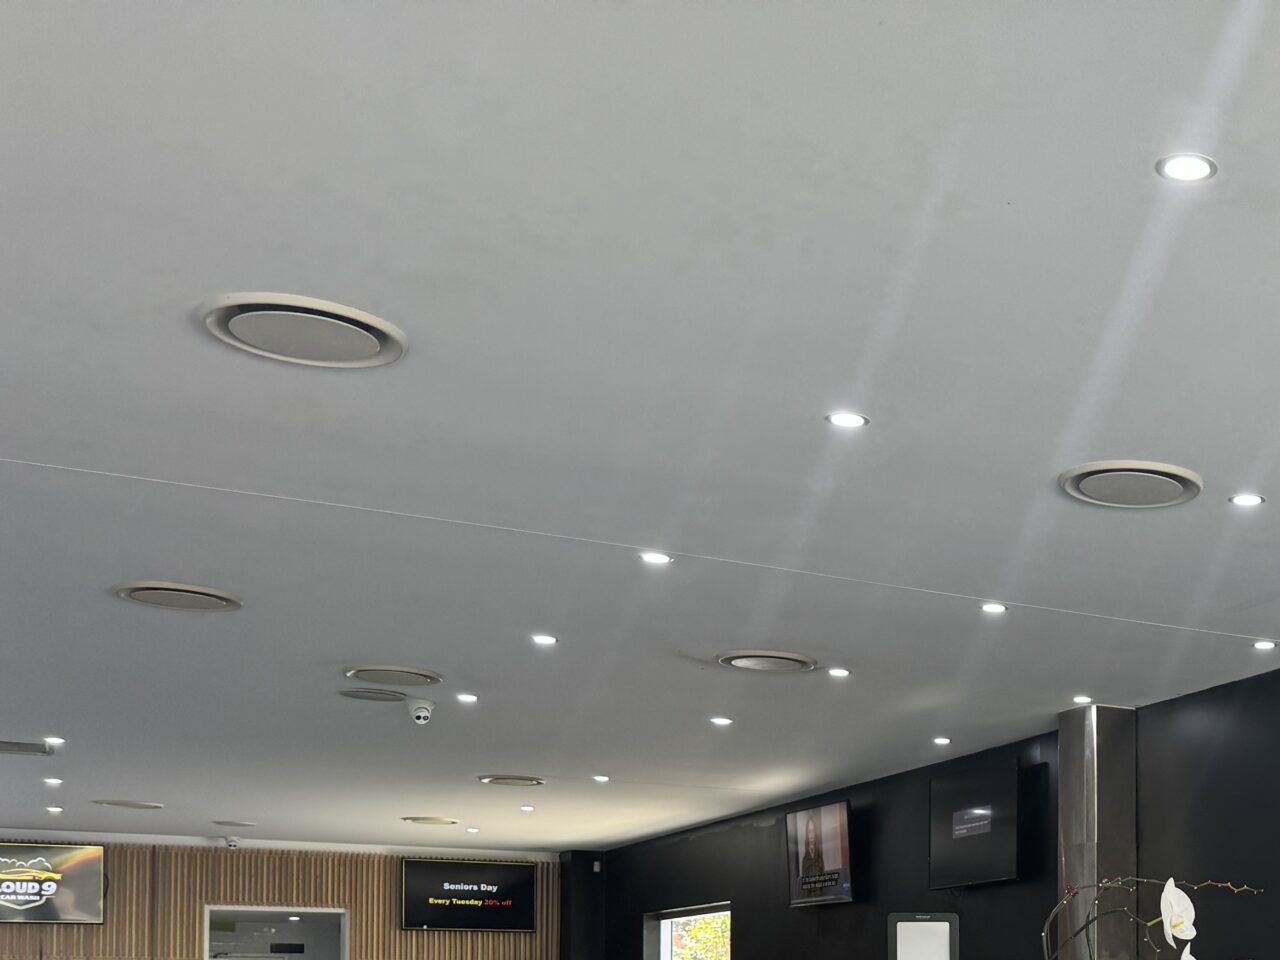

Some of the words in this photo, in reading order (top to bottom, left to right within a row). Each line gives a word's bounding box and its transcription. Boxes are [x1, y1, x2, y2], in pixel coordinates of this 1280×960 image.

[0, 881, 39, 893] OUD
[41, 881, 57, 895] 9
[443, 882, 478, 891] Seniors
[480, 883, 498, 893] Day
[428, 897, 450, 906] Every
[452, 898, 482, 906] Tuesday
